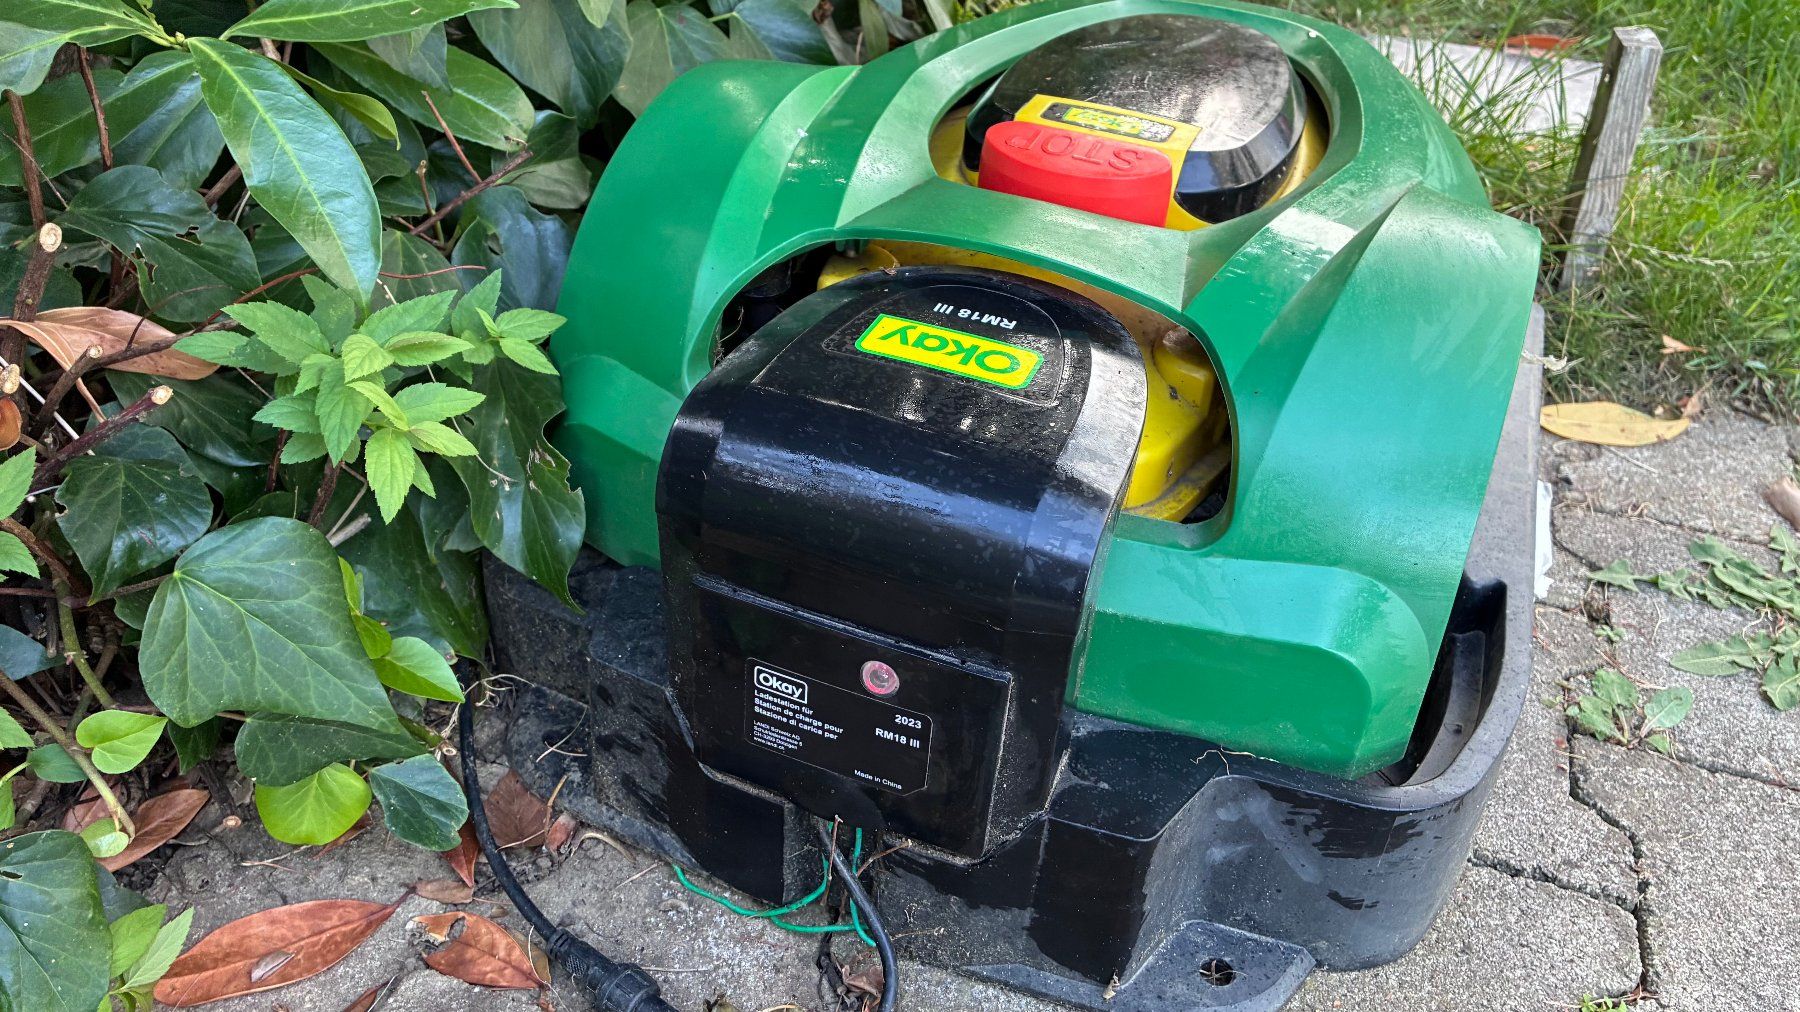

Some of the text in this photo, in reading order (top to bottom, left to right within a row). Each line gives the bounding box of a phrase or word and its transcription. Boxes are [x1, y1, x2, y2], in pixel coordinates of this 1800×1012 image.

[1005, 129, 1144, 171] STOP
[933, 302, 1017, 330] RM18 III
[877, 325, 1021, 374] Okay
[759, 673, 802, 698] Okay
[754, 689, 813, 716] Ladestation für
[754, 697, 844, 734] Station de charge pour
[753, 720, 770, 729] LANDI
[754, 705, 787, 723] Stazione
[798, 722, 822, 735] carica
[824, 731, 838, 740] per
[894, 714, 922, 729] 2023
[875, 727, 920, 749] RM18 III
[854, 769, 902, 790] Made in China
